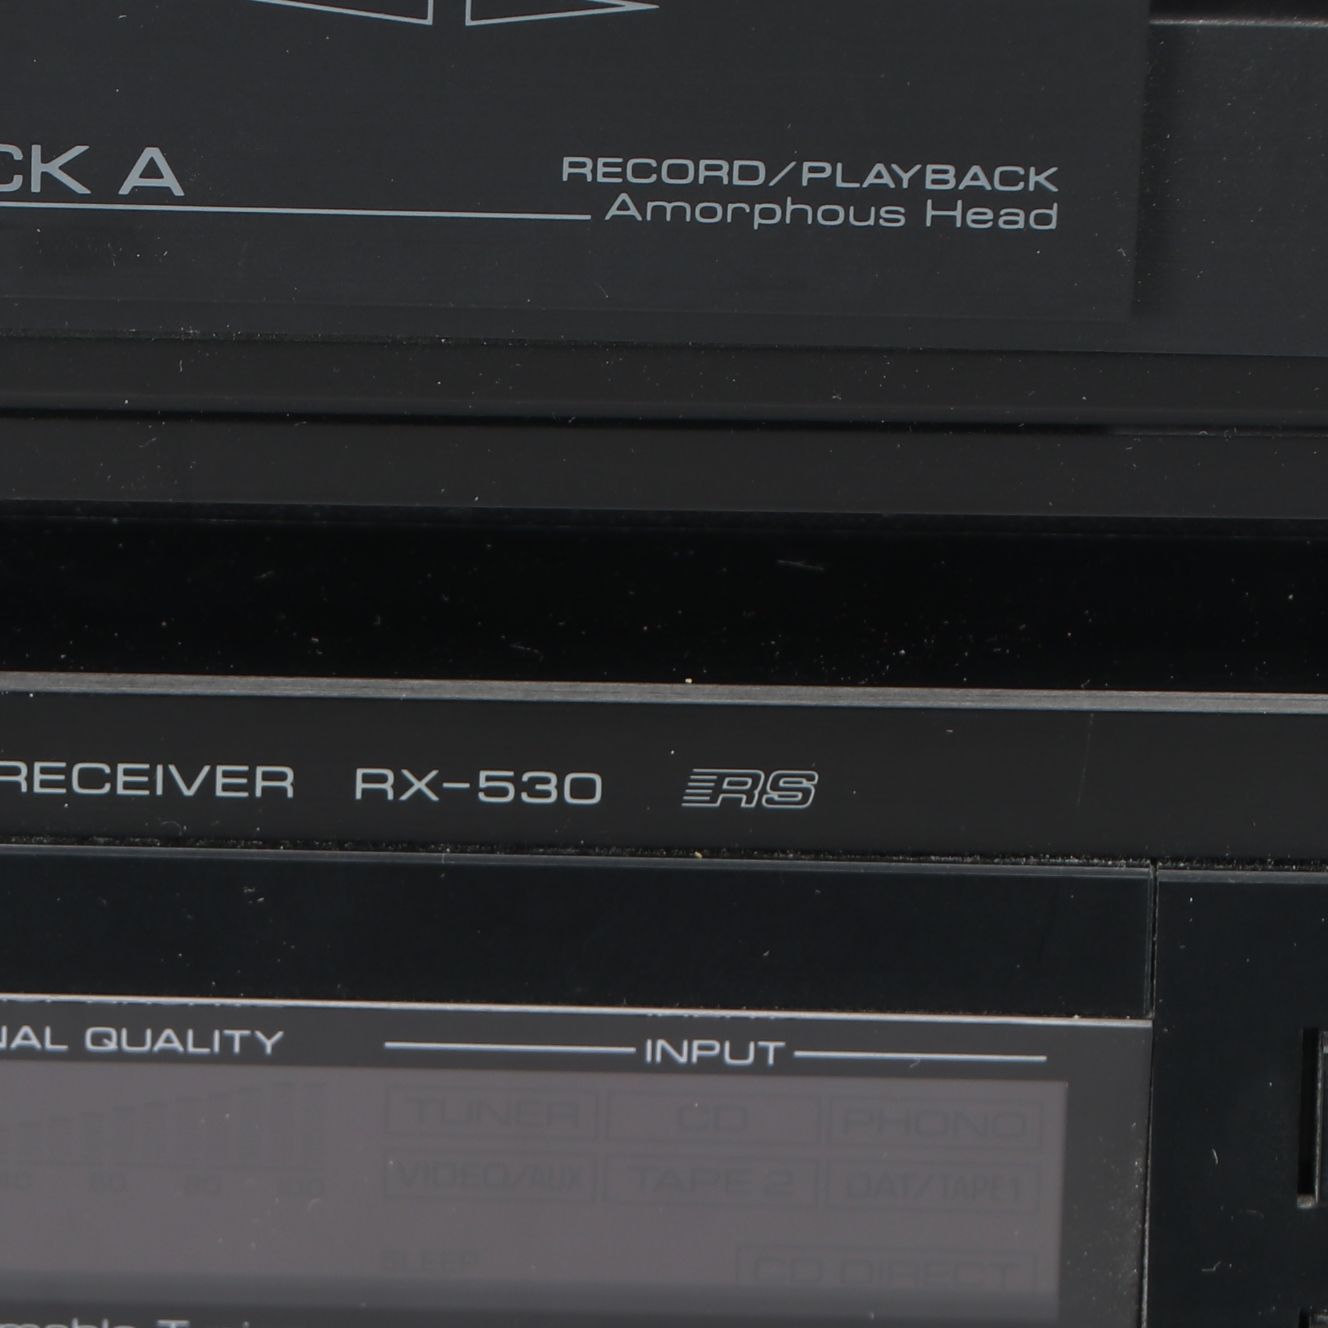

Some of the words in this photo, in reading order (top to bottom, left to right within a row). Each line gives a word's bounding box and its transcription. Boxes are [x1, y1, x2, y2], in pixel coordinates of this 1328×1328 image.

[117, 146, 185, 197] A
[562, 156, 1059, 193] RECORD/PLAYBACK
[604, 192, 906, 230] Amorphous
[925, 198, 1058, 230] Head
[355, 767, 603, 805] RX-530
[84, 1026, 284, 1055] QUALITY
[645, 1038, 786, 1066] INPUT
[405, 1096, 580, 1129] TUNER
[675, 1105, 749, 1134] CD
[841, 1109, 1028, 1140] PHONO
[626, 1162, 753, 1196] TAPE
[763, 1168, 796, 1198] 2
